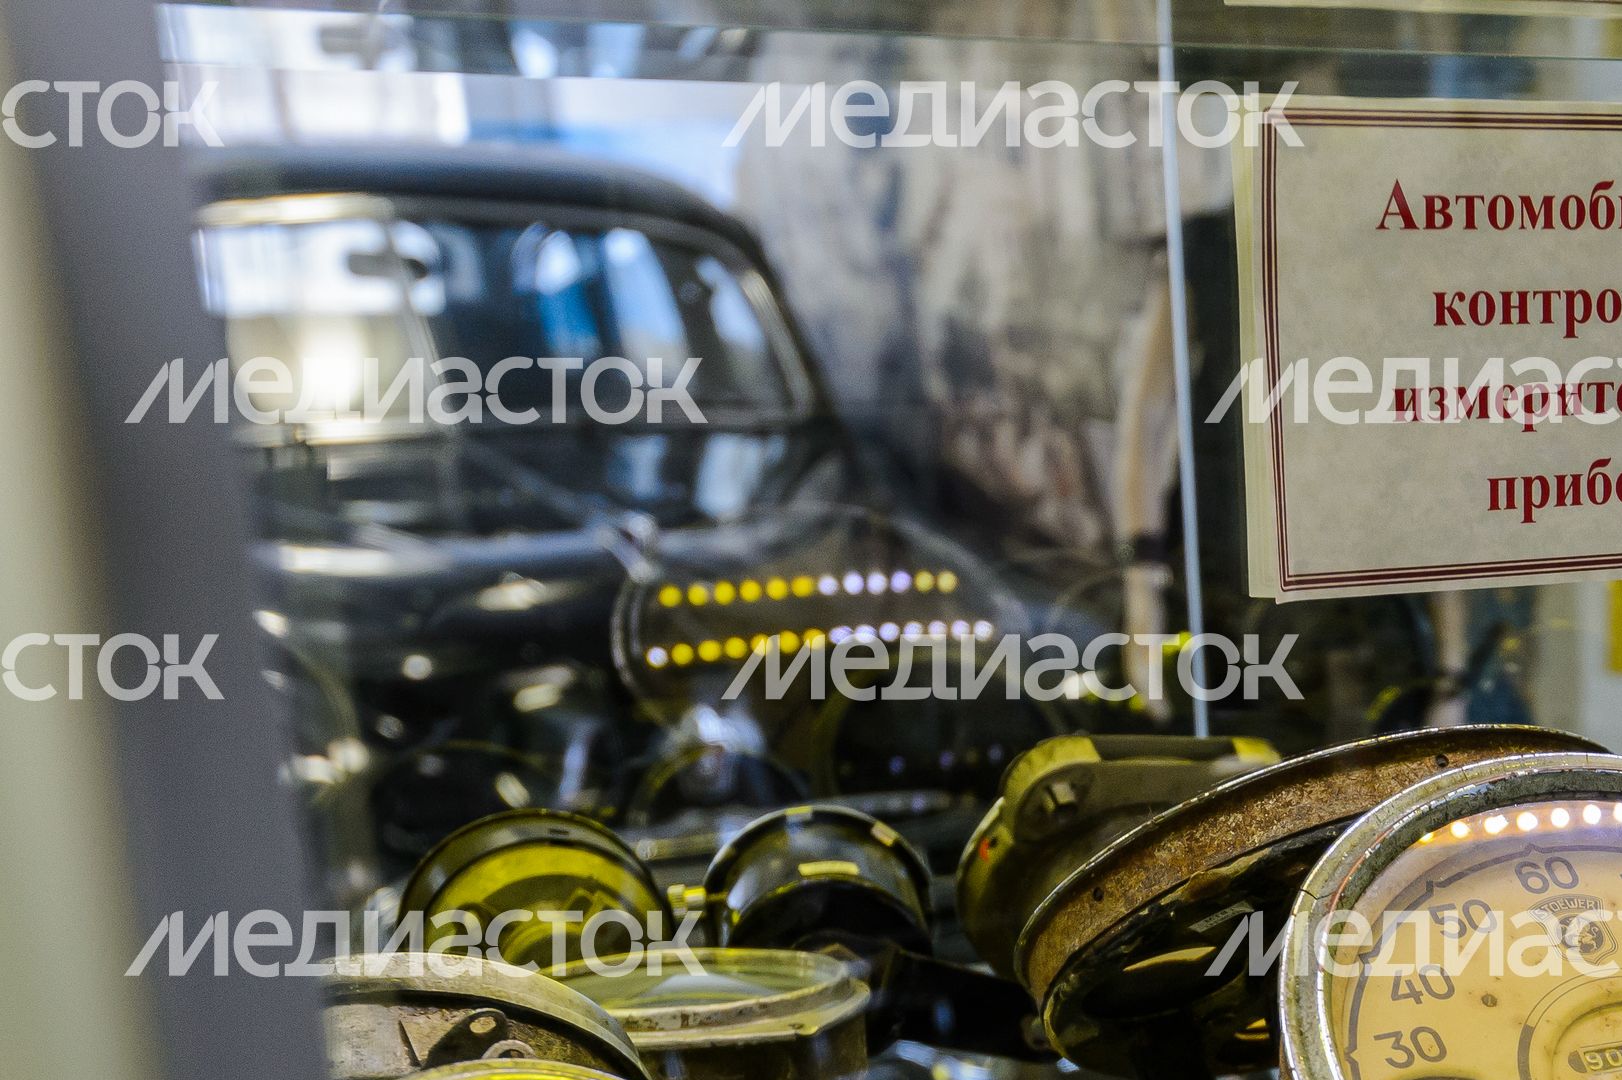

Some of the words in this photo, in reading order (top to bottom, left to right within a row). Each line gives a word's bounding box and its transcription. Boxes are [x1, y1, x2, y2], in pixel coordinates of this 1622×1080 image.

[1514, 855, 1580, 895] 60
[1428, 899, 1498, 940] 50
[1533, 898, 1601, 920] STOEWER
[1390, 963, 1456, 1006] 40
[1373, 1026, 1448, 1070] 30
